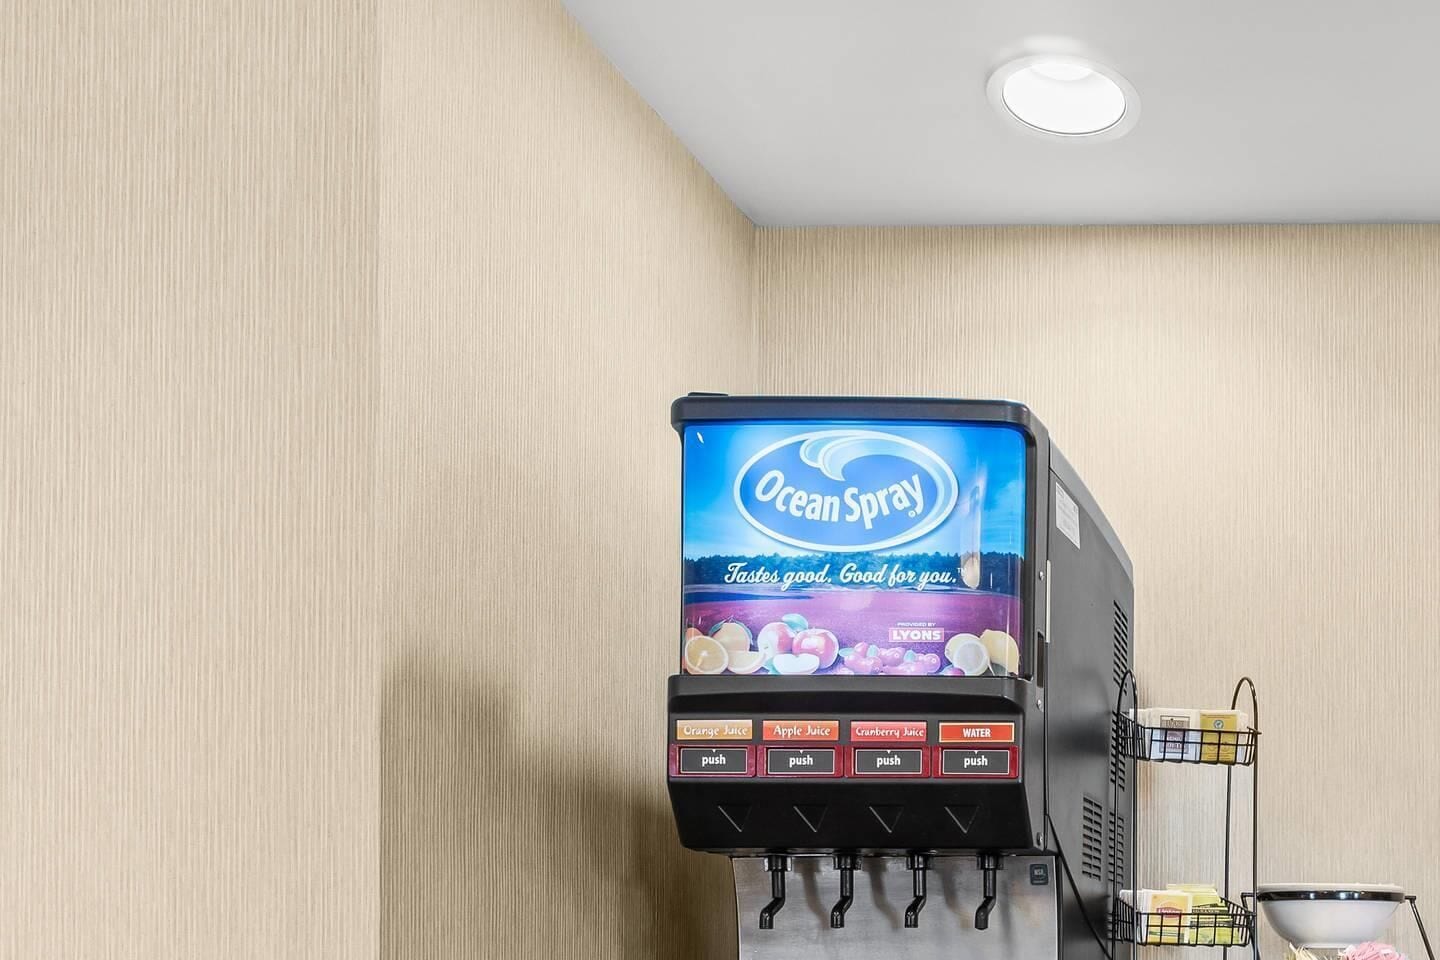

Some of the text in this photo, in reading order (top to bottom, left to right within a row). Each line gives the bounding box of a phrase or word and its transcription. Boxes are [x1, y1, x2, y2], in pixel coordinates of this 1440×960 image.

[754, 470, 925, 530] Ocean Spray
[724, 562, 781, 584] Tastes
[782, 563, 833, 592] good.
[839, 562, 891, 584] Good
[887, 563, 916, 587] for
[892, 630, 941, 640] LYONS
[683, 725, 749, 738] Orange Juice
[773, 725, 831, 738] Apple Juice
[855, 727, 925, 738] Cranberry Juice
[962, 728, 991, 738] WATER
[701, 754, 726, 767] push
[789, 754, 814, 768] push
[876, 755, 901, 768] push
[963, 755, 988, 769] push
